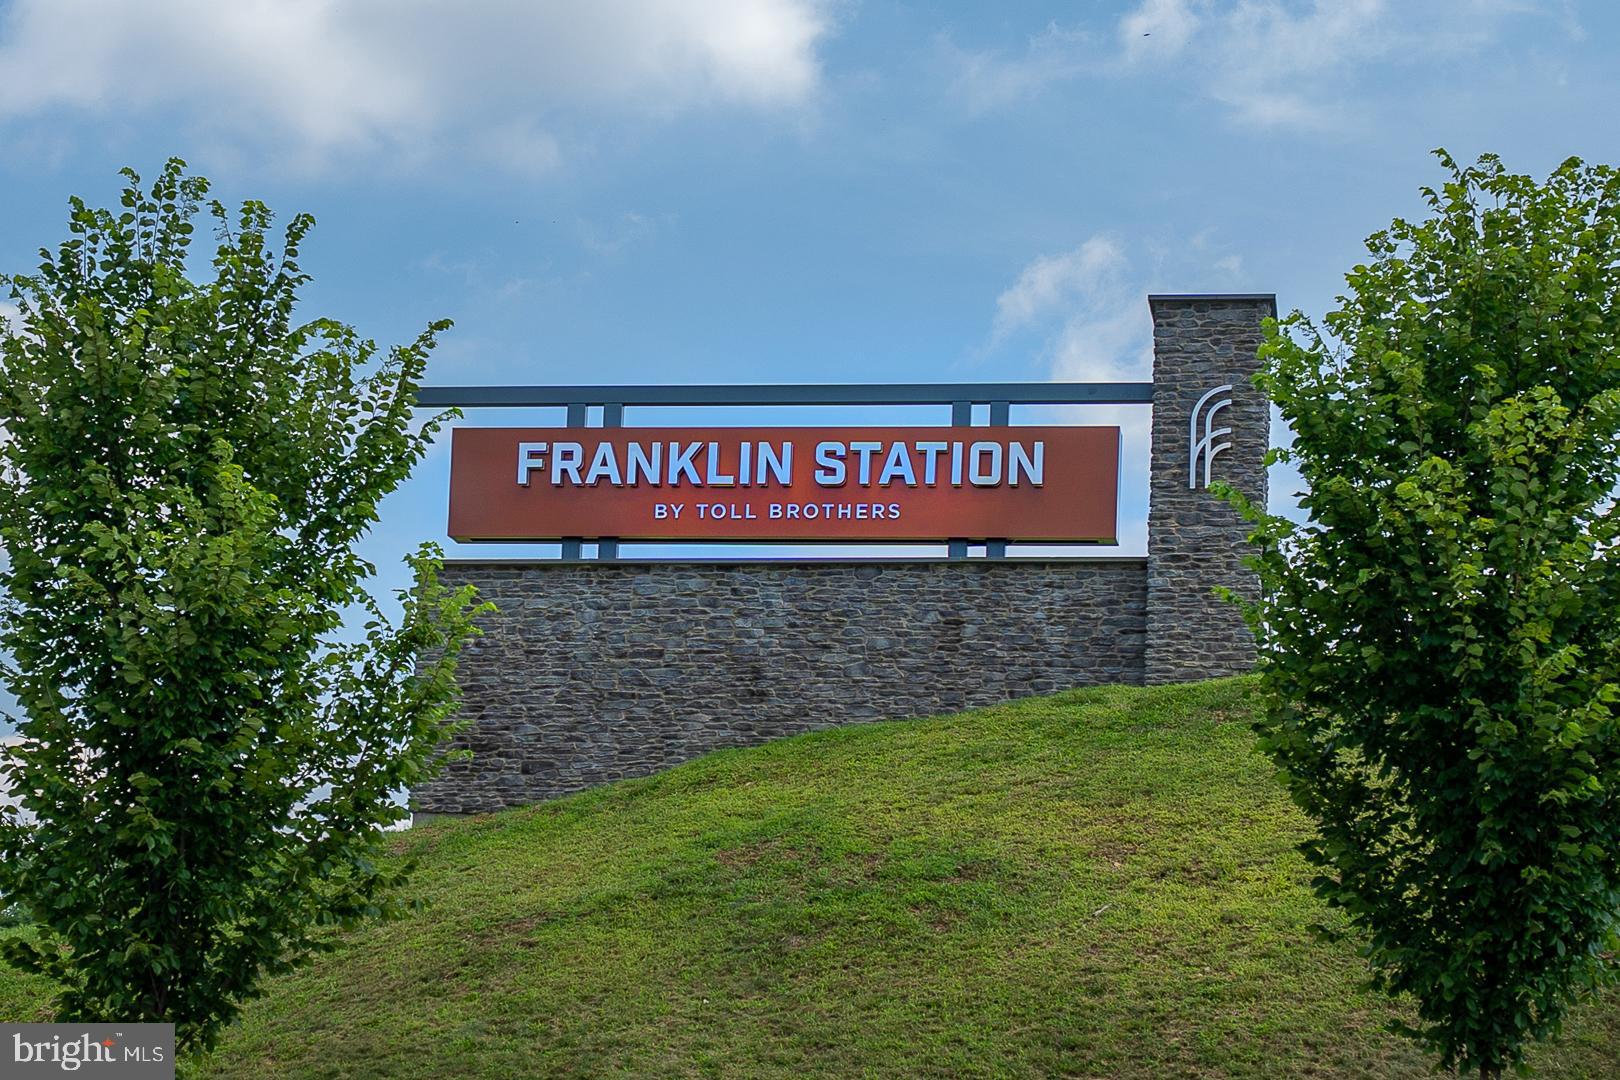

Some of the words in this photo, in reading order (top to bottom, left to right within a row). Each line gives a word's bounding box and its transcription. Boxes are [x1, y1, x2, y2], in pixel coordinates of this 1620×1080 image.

[516, 440, 793, 487] FRANKLIN
[814, 440, 1045, 487] STATION
[653, 502, 684, 519] BY
[695, 502, 757, 519] TOLL
[769, 502, 901, 519] BROTHERS
